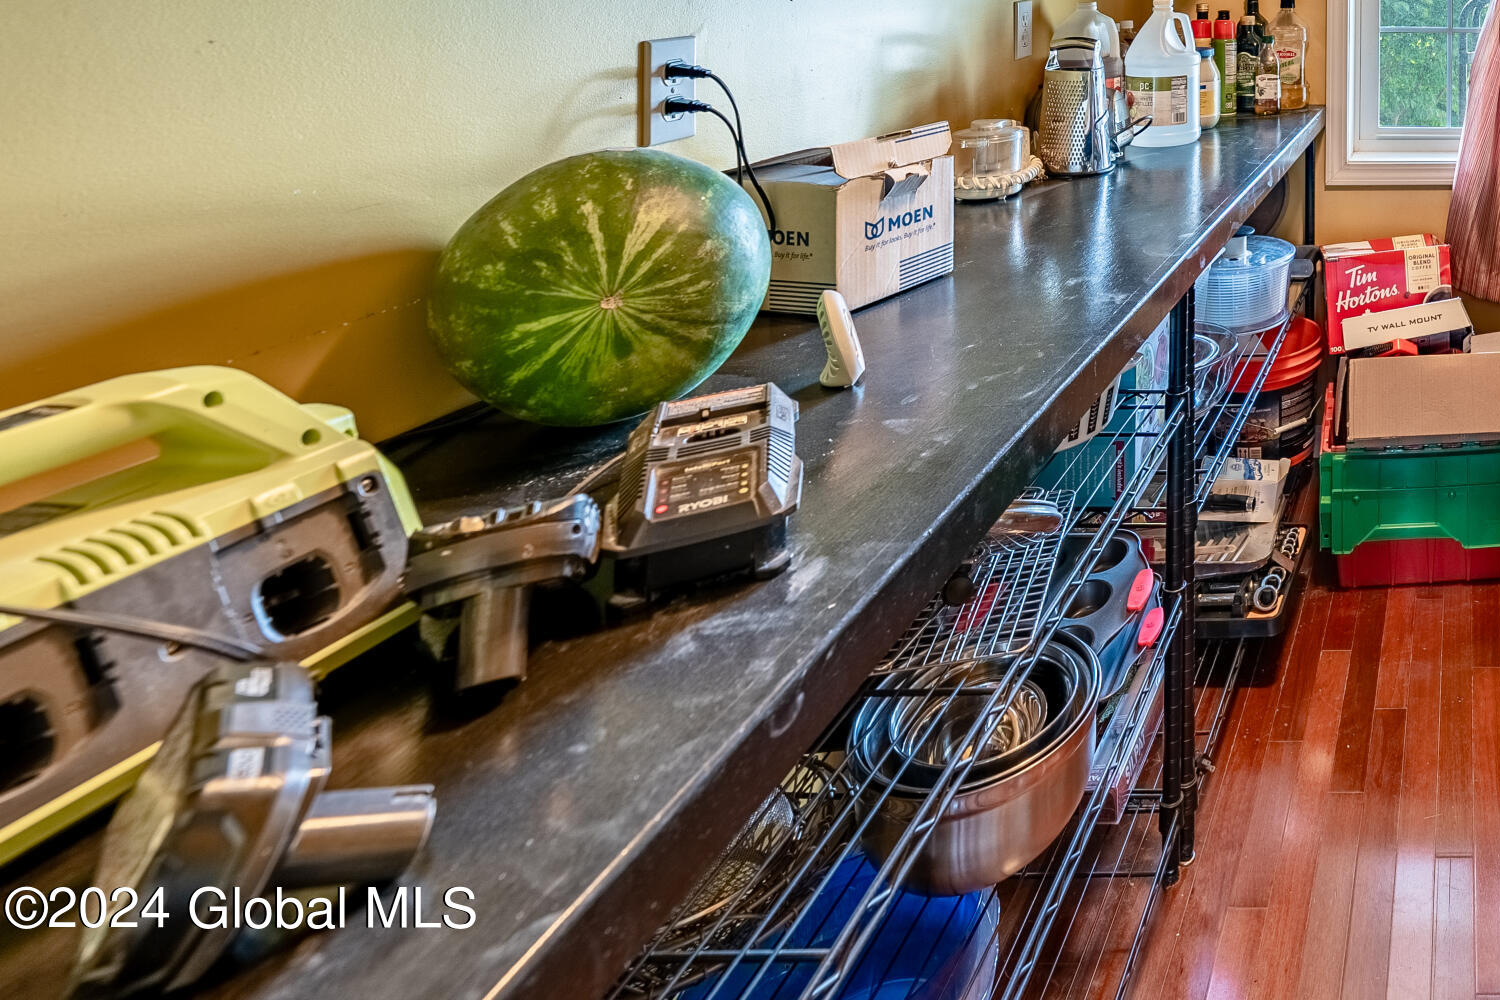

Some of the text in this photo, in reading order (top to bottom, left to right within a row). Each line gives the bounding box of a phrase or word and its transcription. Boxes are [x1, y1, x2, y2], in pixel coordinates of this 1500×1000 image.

[887, 204, 933, 232] MOEN
[771, 229, 810, 247] OEN
[864, 243, 876, 252] Buy
[903, 231, 913, 242] Buy
[774, 251, 786, 260] Buy
[1408, 253, 1435, 261] ORIGINAL
[1344, 264, 1377, 289] Tim
[1335, 284, 1399, 313] Hortons
[1367, 313, 1443, 333] TV WALL MOUNT
[1330, 345, 1342, 353] 100
[678, 494, 728, 514] RYOBI
